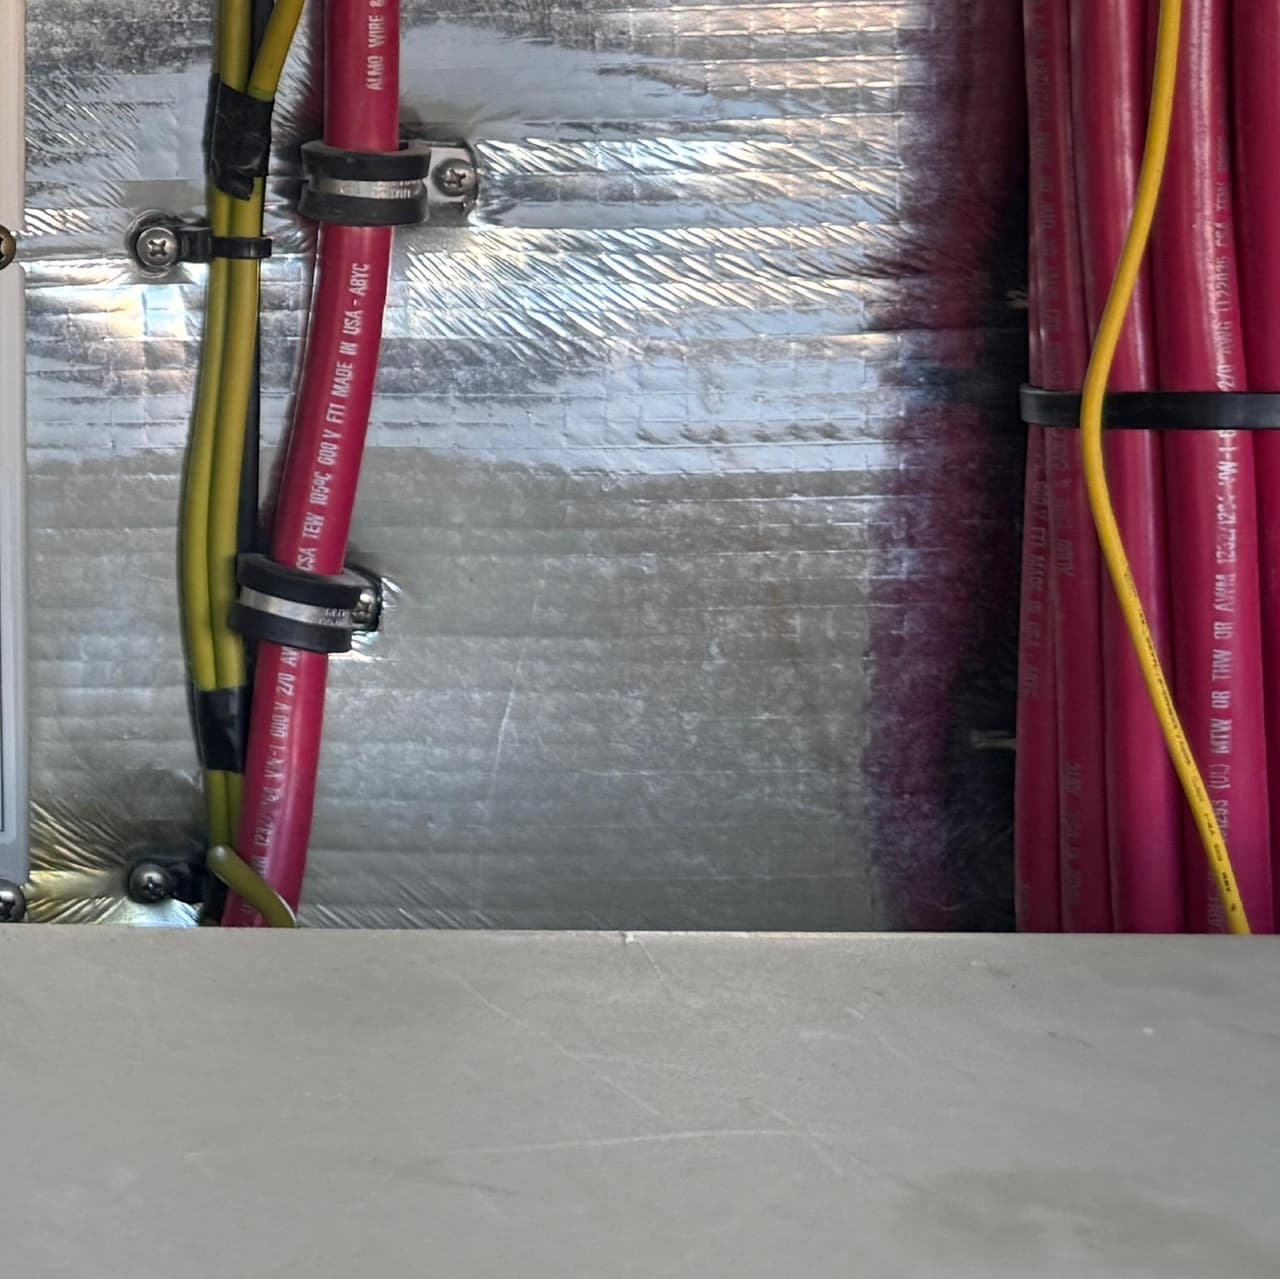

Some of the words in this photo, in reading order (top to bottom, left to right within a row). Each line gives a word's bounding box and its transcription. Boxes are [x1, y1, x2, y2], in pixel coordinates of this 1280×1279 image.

[367, 15, 384, 49] WIRE
[365, 56, 383, 91] ALMO
[347, 262, 370, 296] ABYC
[340, 309, 362, 335] USA
[336, 341, 357, 356] IN
[328, 361, 352, 398] MADE
[1215, 364, 1236, 391] 2/0
[321, 429, 342, 441] V
[315, 441, 338, 466] 600
[301, 512, 324, 541] TEW
[295, 548, 317, 572] CSA
[1212, 574, 1236, 613] AWM
[1213, 622, 1234, 640] OR
[280, 647, 302, 668] AW
[1211, 649, 1233, 681] THW
[276, 673, 297, 696] 2/0
[1210, 691, 1232, 709] OR
[1209, 718, 1233, 754] MTW
[1207, 764, 1231, 790] (UL)
